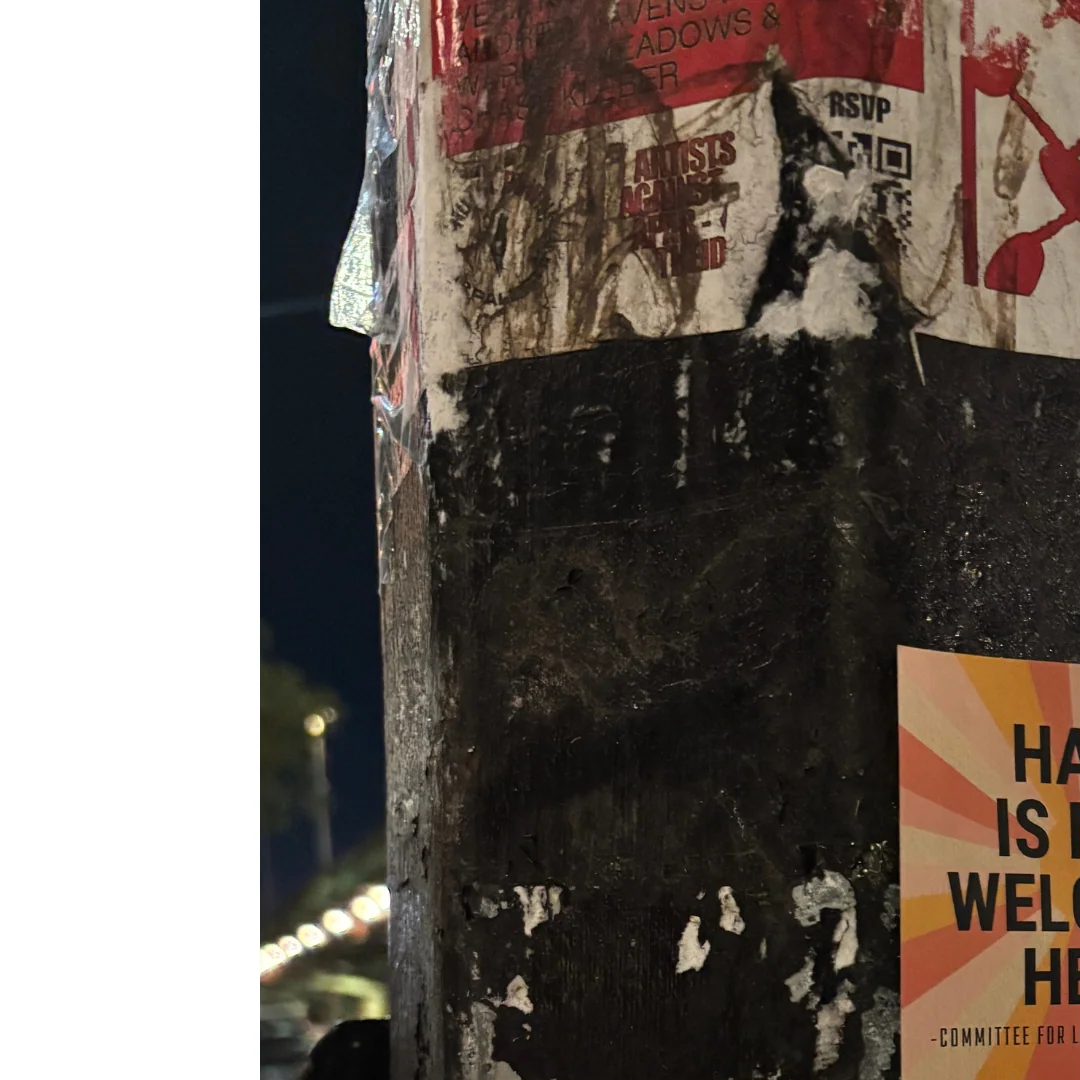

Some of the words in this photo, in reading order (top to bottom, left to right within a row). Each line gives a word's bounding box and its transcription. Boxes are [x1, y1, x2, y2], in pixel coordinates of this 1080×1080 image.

[828, 90, 891, 123] RSVP
[634, 131, 736, 183] ARTISTS
[996, 798, 1049, 858] IS
[930, 1025, 1030, 1048] -COMMITTEE
[1037, 1025, 1065, 1045] FOR
